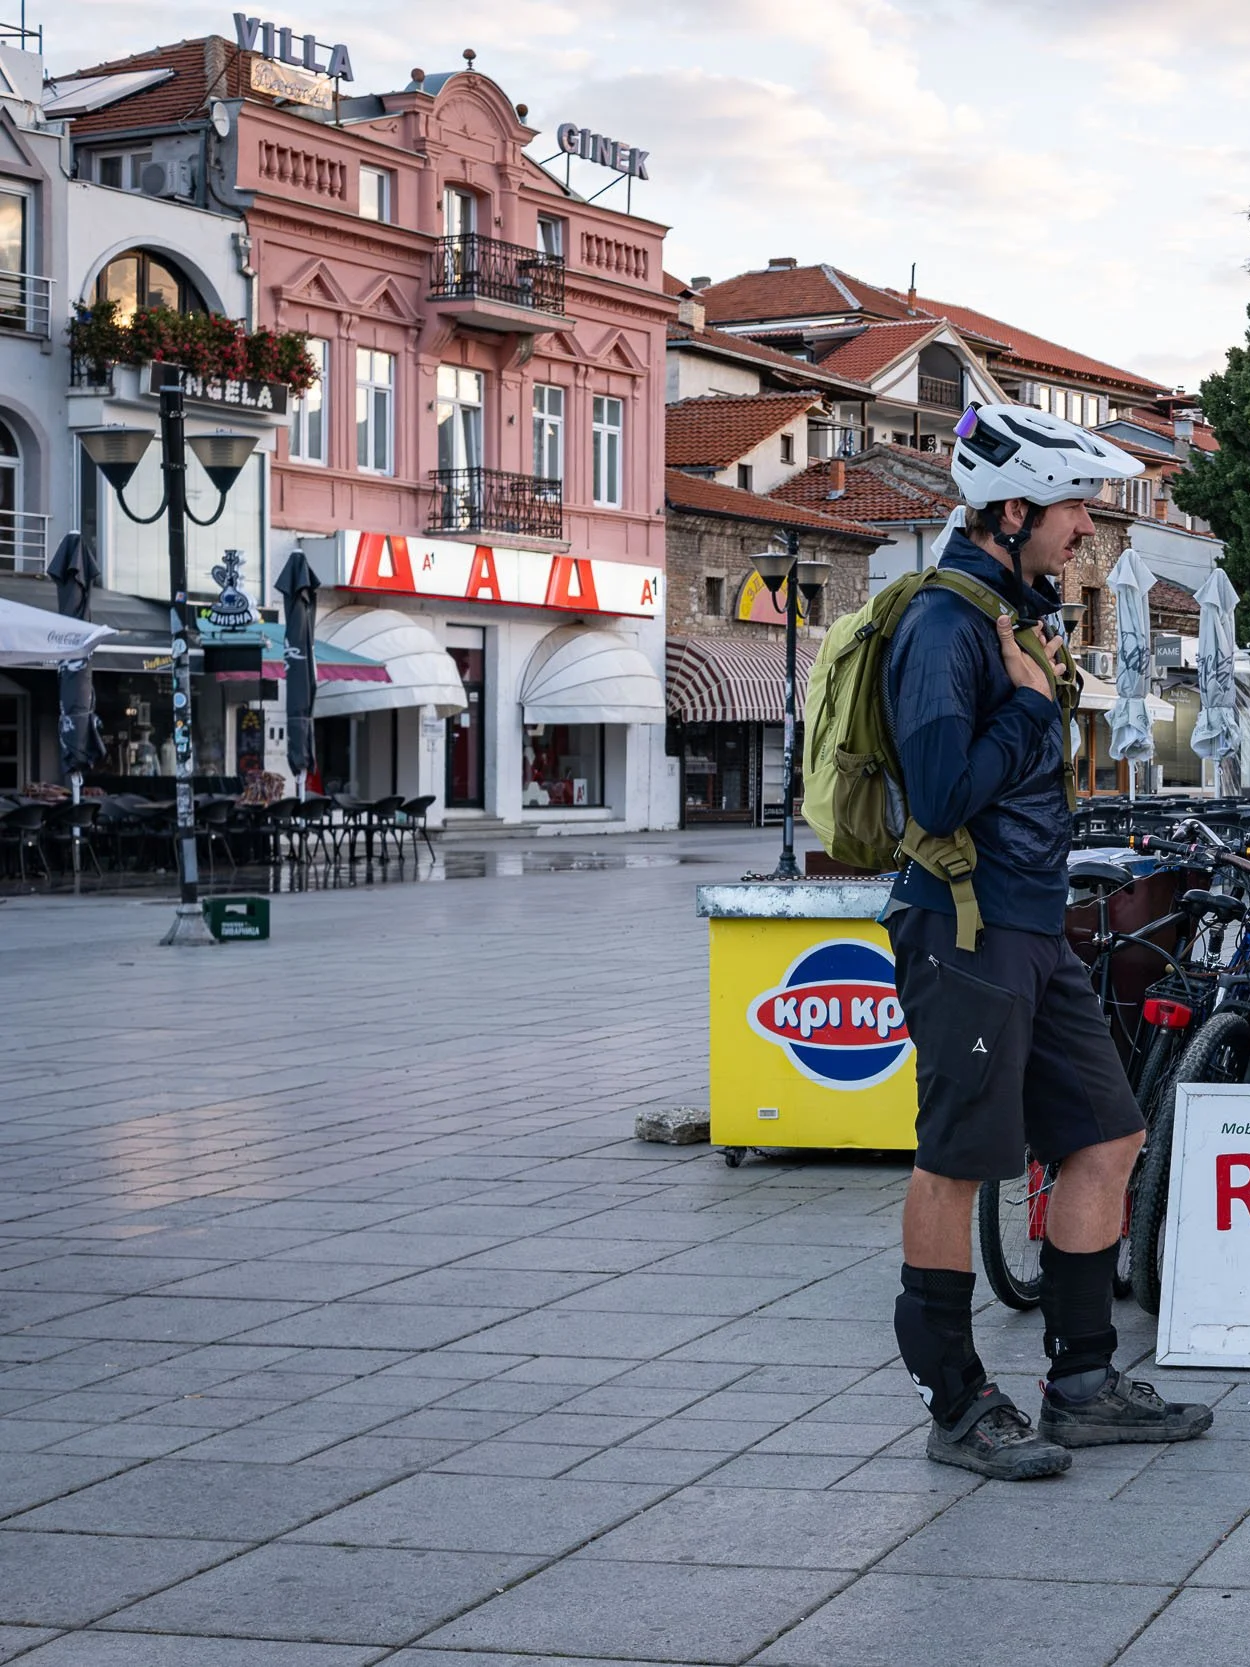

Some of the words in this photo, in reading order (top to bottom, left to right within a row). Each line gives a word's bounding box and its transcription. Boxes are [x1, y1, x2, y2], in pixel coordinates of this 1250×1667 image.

[233, 12, 354, 81] VILLA
[557, 123, 650, 181] GINEK
[179, 370, 274, 409] NGELA
[466, 545, 502, 600] A
[641, 576, 658, 605] A1
[1157, 647, 1180, 656] KAME
